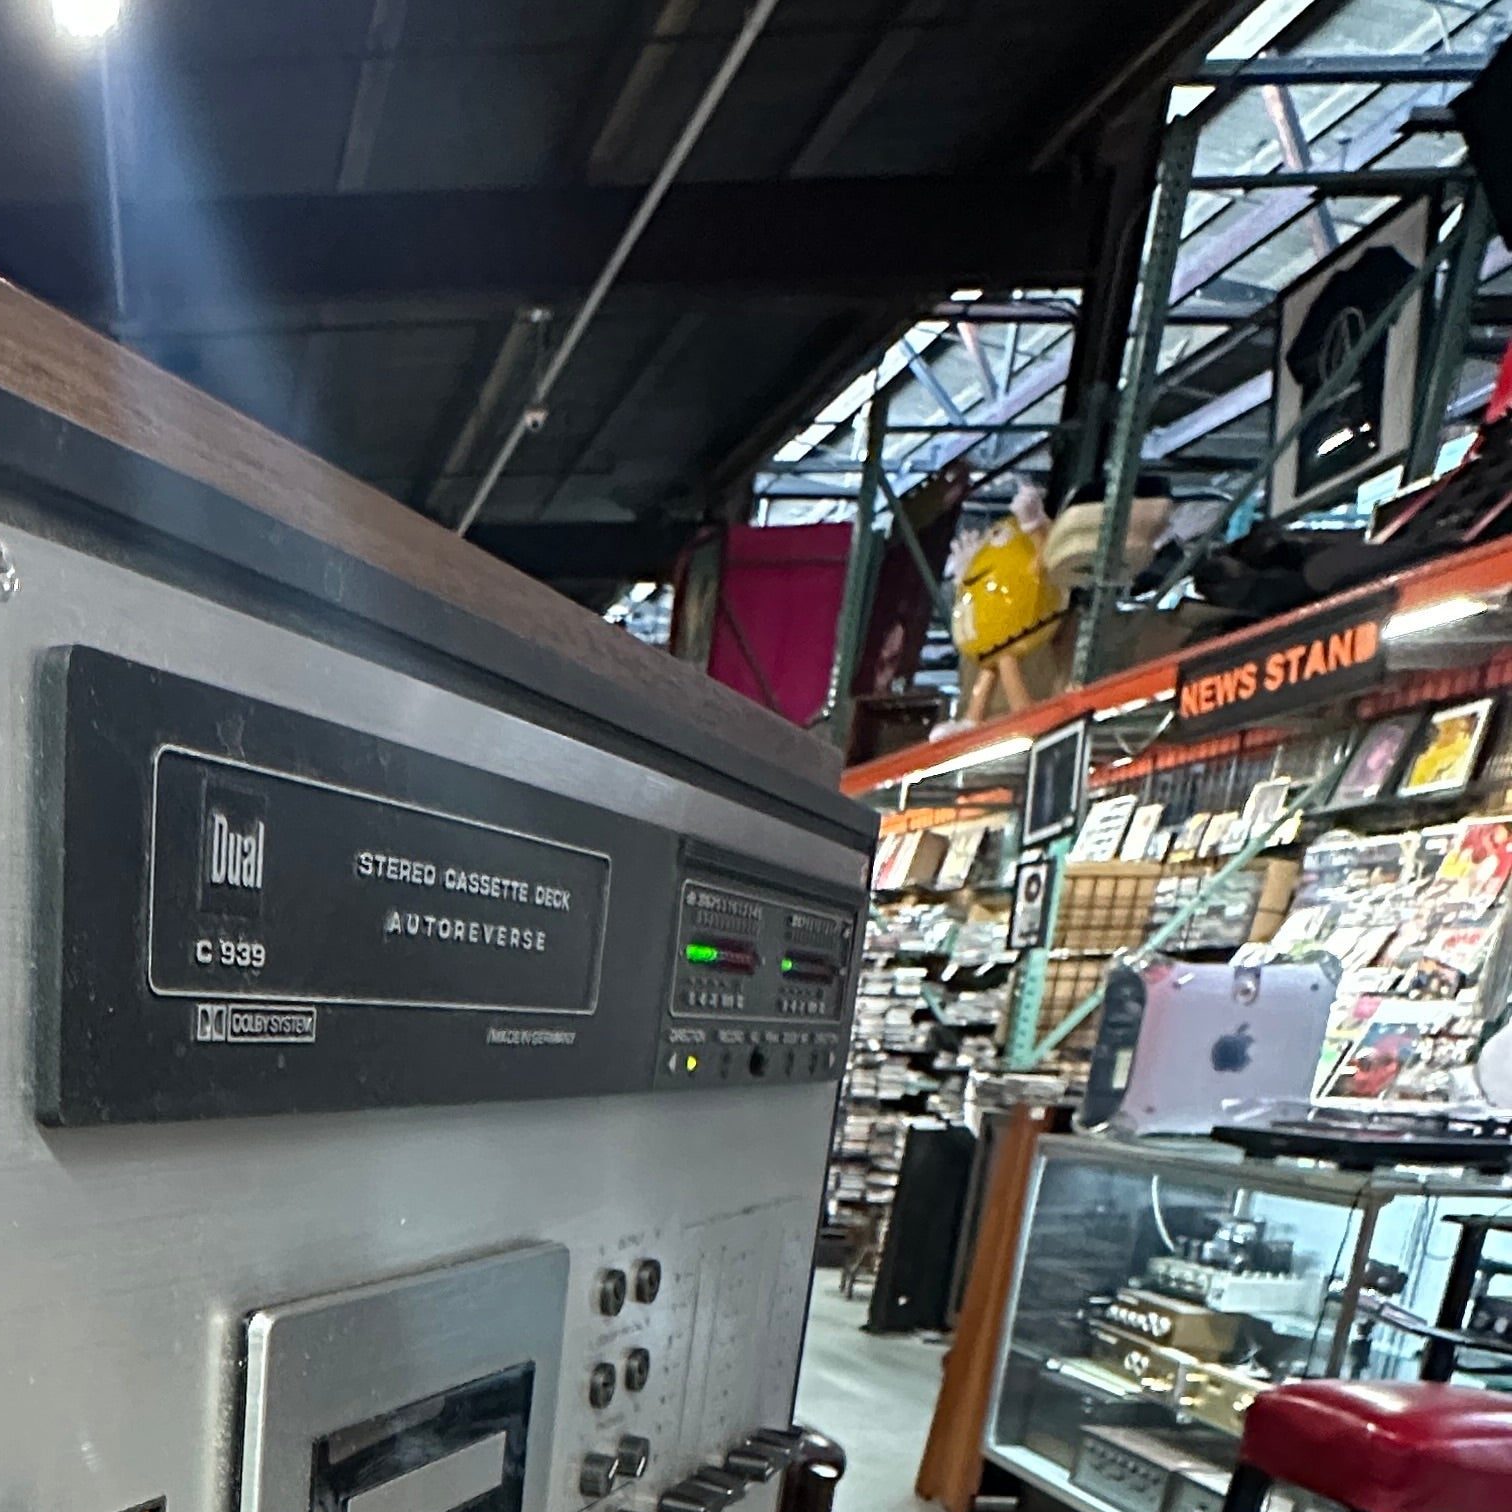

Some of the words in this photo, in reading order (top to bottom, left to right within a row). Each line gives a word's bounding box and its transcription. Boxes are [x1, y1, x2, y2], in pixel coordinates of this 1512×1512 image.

[1179, 662, 1258, 718] NEWS
[1264, 621, 1379, 692] STAND
[212, 814, 264, 888] Dual
[359, 852, 436, 886] STEREO
[445, 868, 530, 903] CASSETTE
[535, 886, 571, 911] DECK
[196, 940, 212, 964] C
[220, 939, 266, 968] 939
[387, 911, 546, 950] AUTOREVERSE
